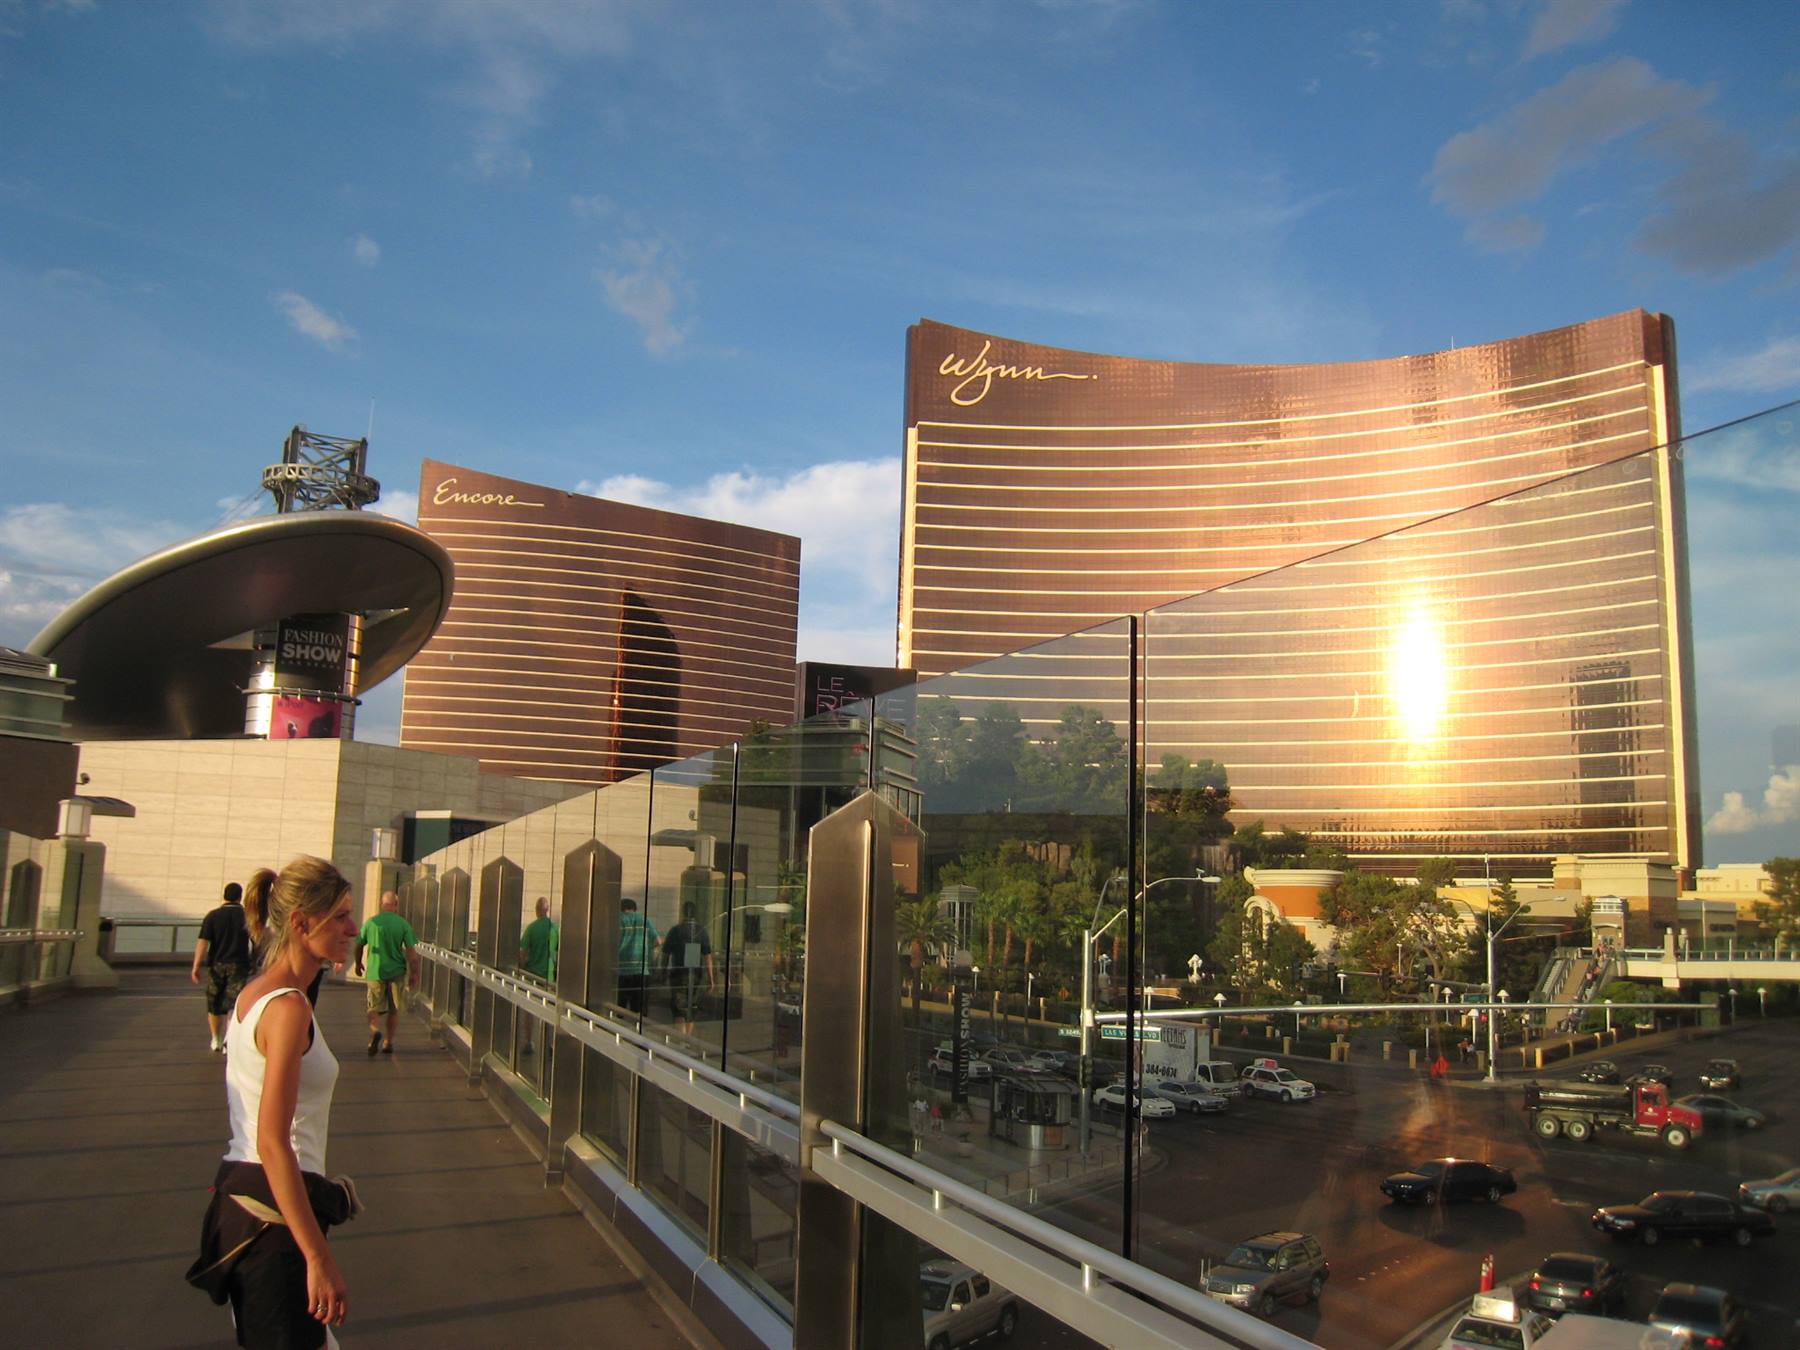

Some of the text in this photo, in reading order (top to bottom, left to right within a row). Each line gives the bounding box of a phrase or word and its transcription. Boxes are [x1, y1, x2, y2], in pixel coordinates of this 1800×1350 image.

[433, 478, 545, 506] Encore
[283, 628, 344, 647] FASHION
[282, 643, 341, 663] SHOW
[817, 675, 844, 693] LE
[960, 992, 971, 1040] SHOW
